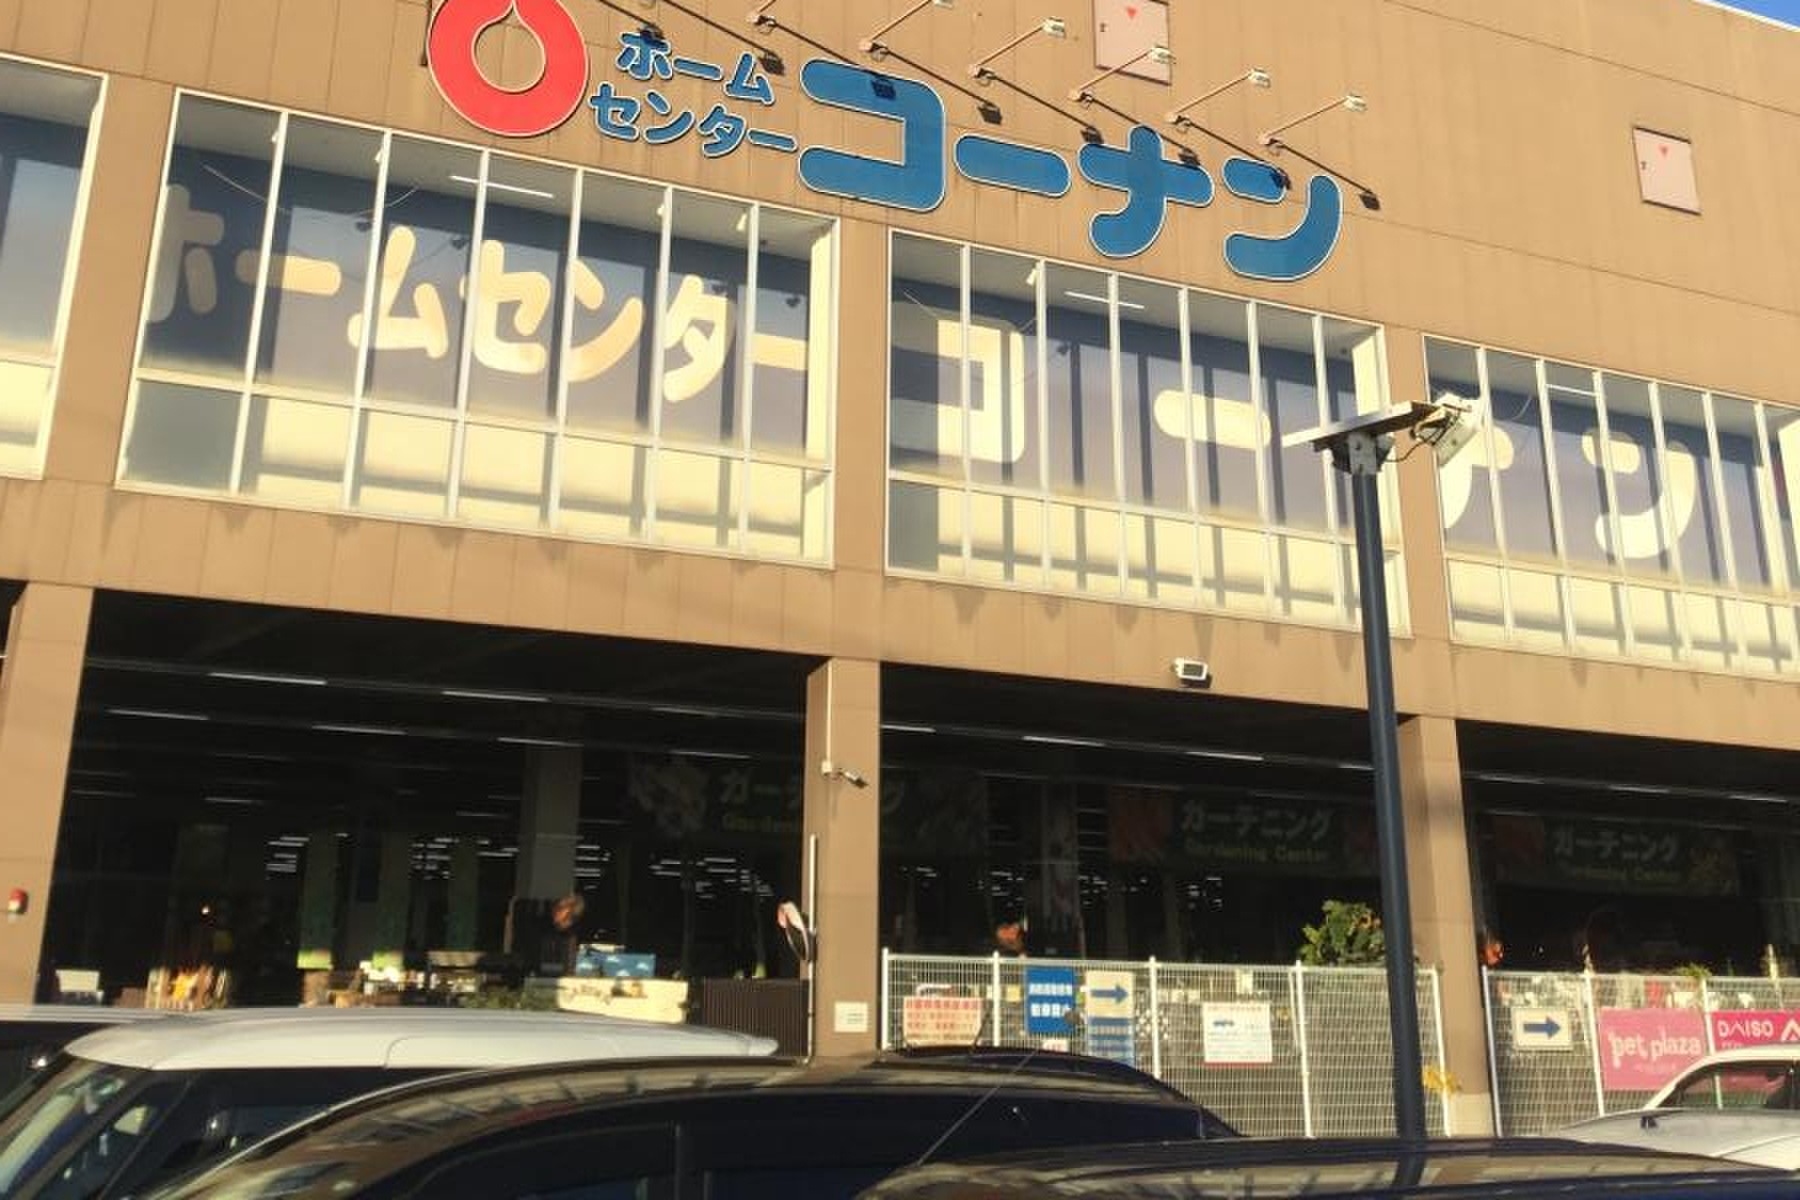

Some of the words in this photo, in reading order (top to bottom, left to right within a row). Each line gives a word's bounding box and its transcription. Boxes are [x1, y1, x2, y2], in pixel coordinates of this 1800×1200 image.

[615, 30, 775, 106] ホーム
[589, 82, 798, 158] センター
[799, 58, 1343, 281] コーナン
[1608, 1031, 1648, 1069] pet
[1650, 1025, 1701, 1062] plaza
[1717, 1019, 1775, 1038] DAISO
